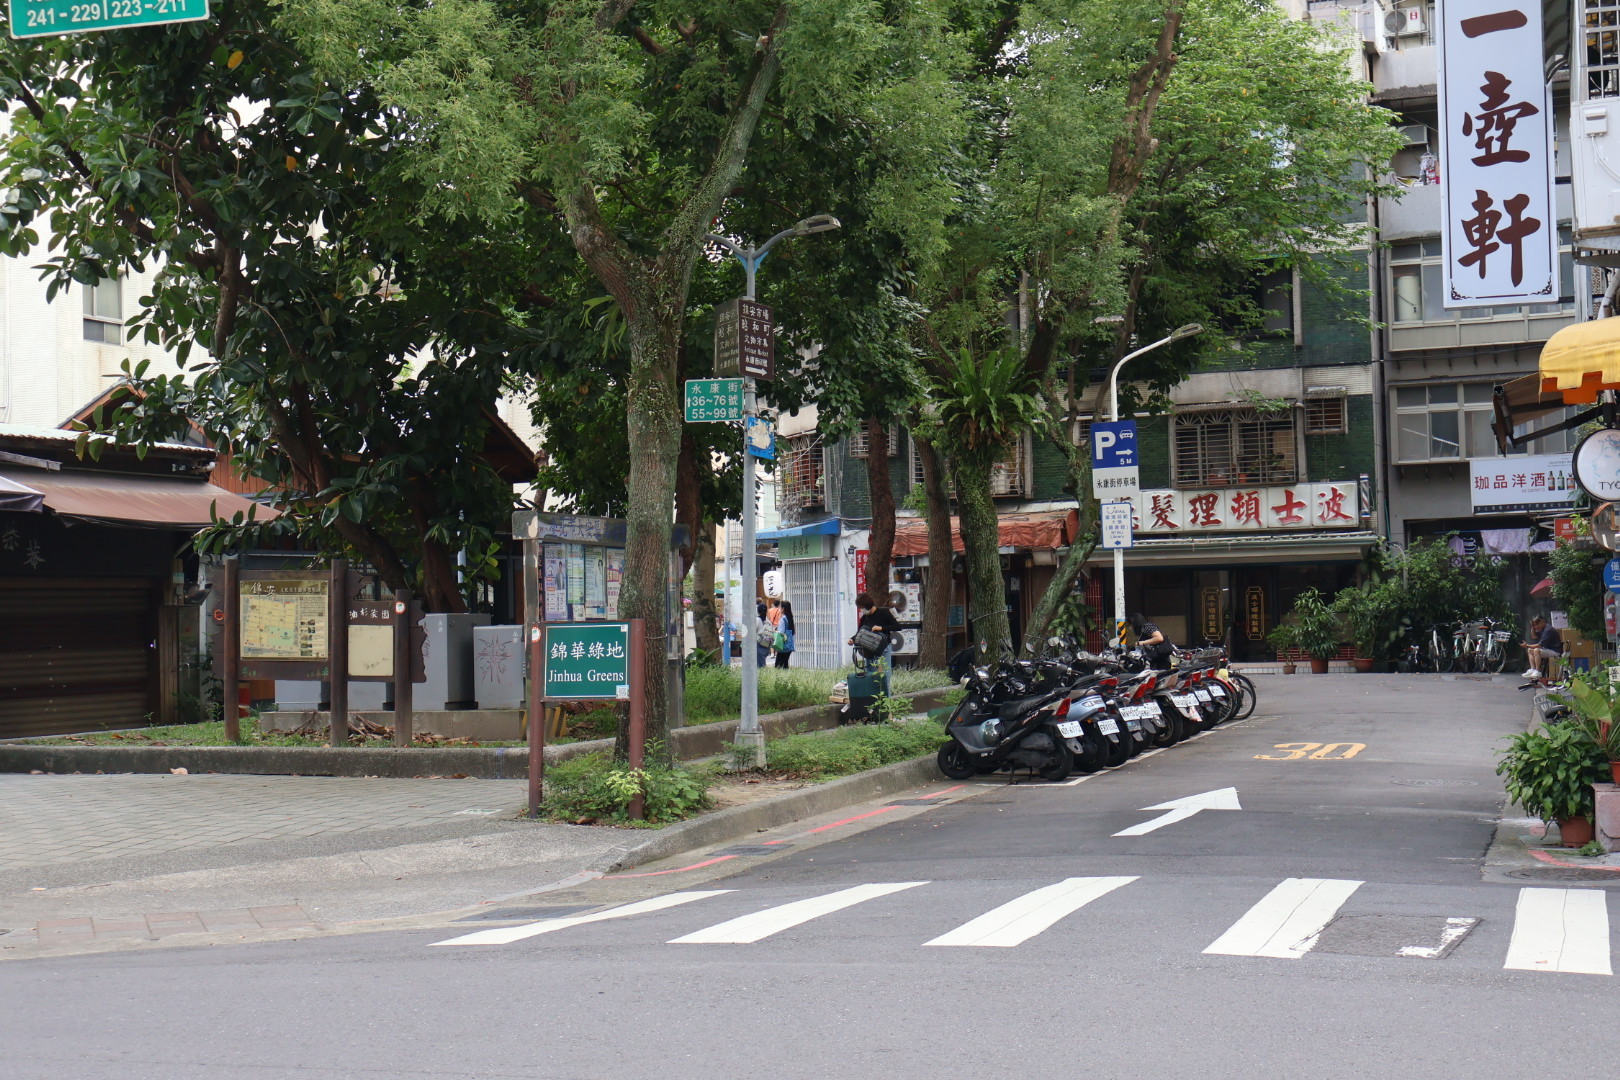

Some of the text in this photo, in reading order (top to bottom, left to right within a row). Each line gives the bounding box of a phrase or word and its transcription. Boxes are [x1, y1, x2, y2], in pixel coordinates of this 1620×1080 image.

[691, 382, 738, 394] 永康街
[1094, 431, 1116, 460] P
[1119, 486, 1354, 530] 波士頓理髮
[550, 641, 625, 661] 錦華綠地
[548, 669, 624, 683] Jinhua Greens
[1252, 742, 1367, 760] 30
